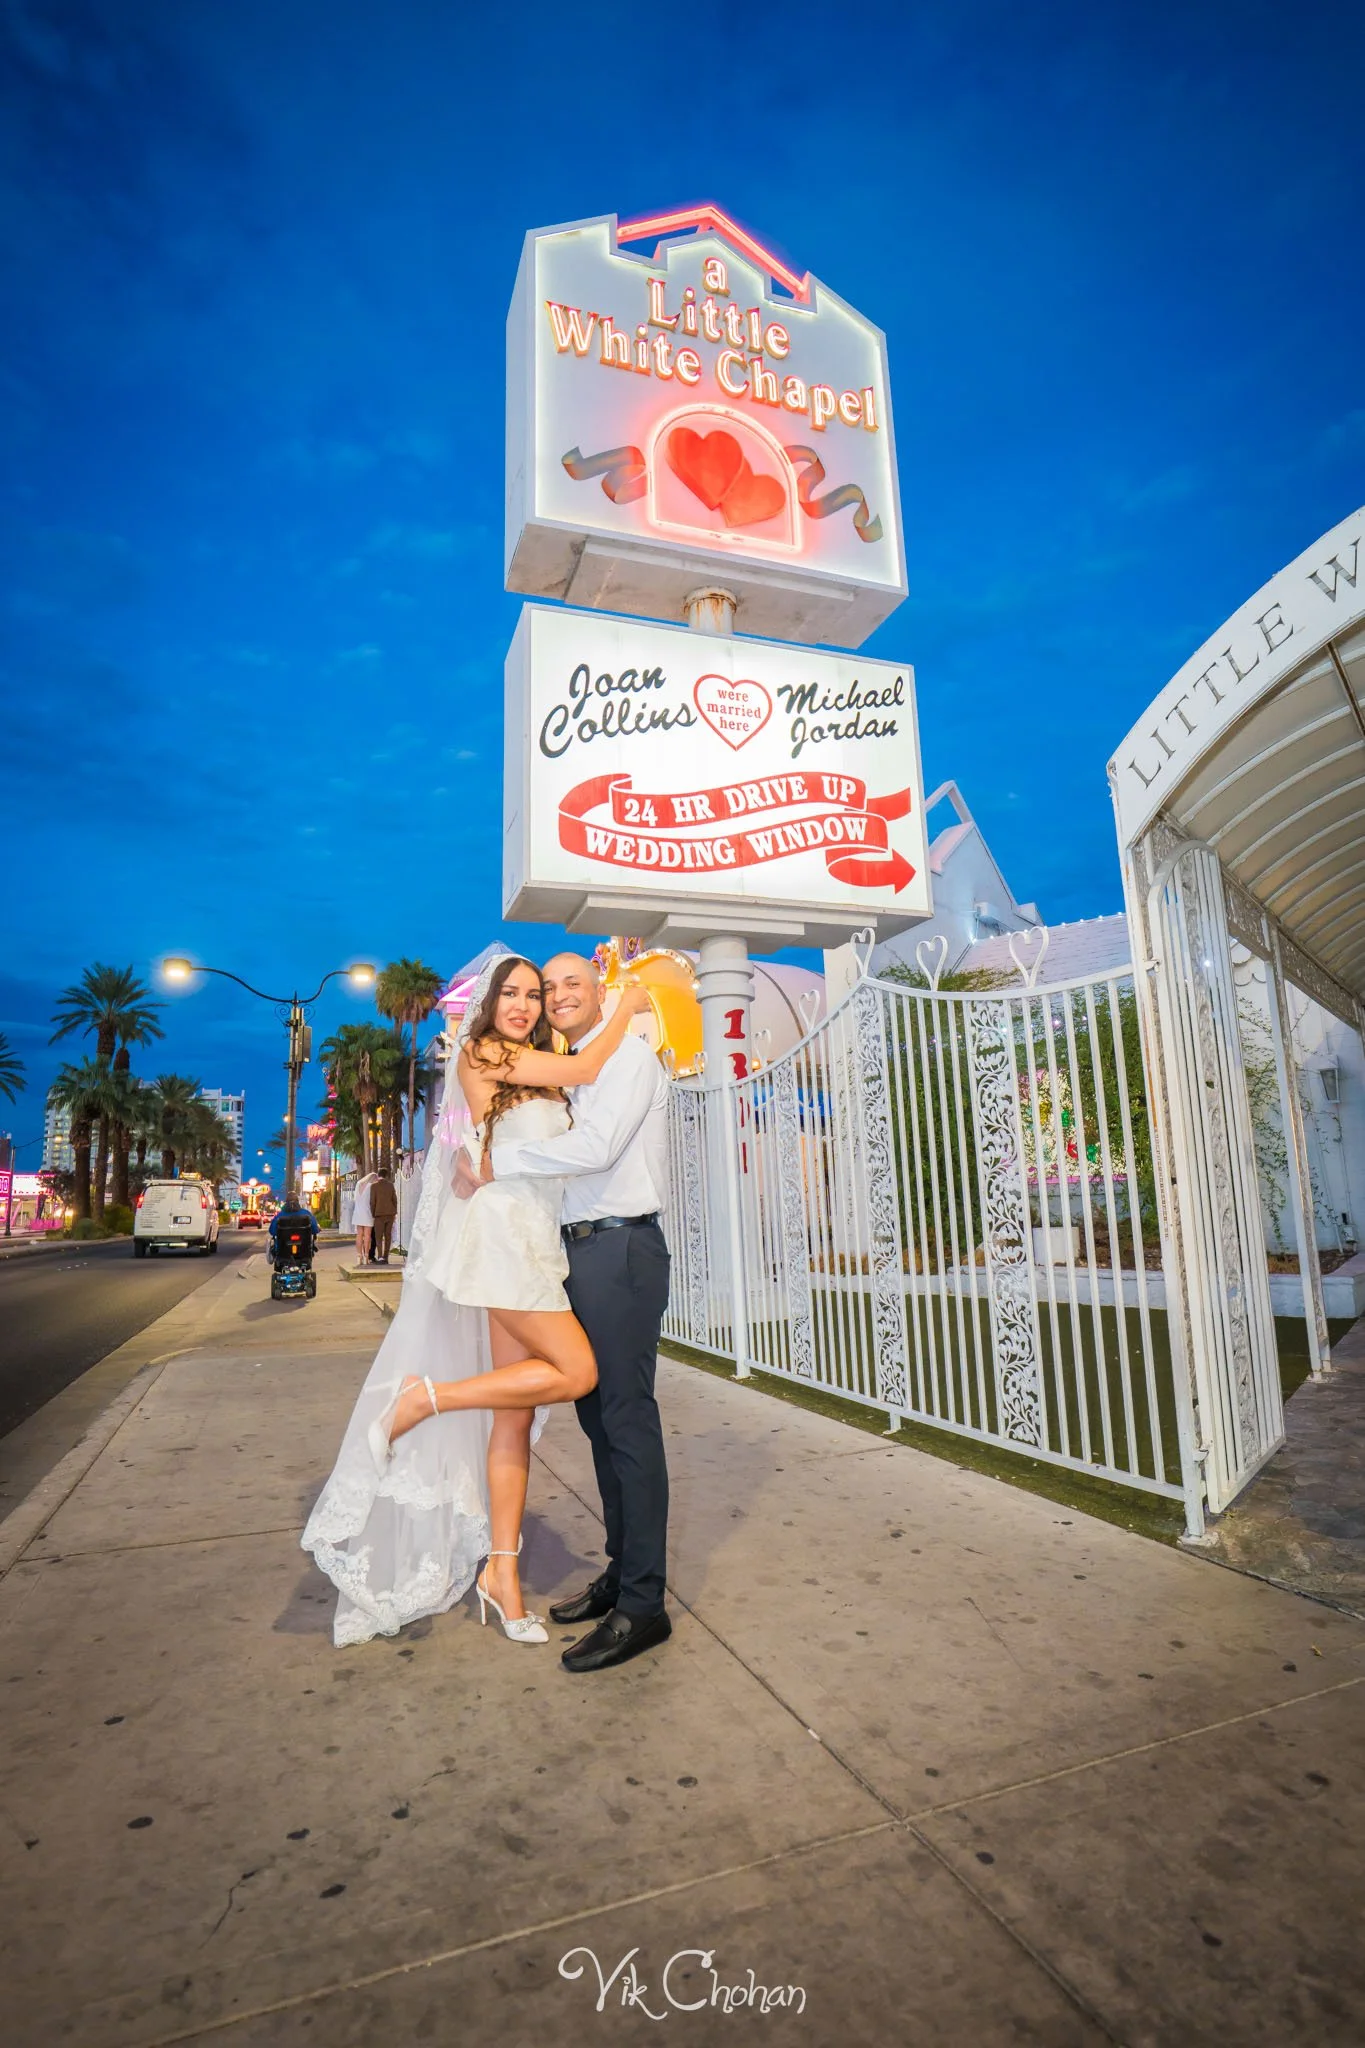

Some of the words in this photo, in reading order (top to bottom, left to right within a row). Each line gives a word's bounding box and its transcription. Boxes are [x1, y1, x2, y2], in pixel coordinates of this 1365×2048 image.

[702, 255, 730, 297] a
[647, 278, 790, 361] Little
[546, 301, 701, 386] White
[715, 349, 881, 432] Chapel
[569, 664, 667, 719] Joan
[706, 702, 762, 719] married
[717, 688, 749, 702] were
[777, 676, 905, 713] Michael
[1128, 602, 1294, 789] LITTLE
[539, 698, 698, 759] Collins
[719, 717, 750, 733] here
[790, 713, 899, 759] Jordan
[624, 799, 658, 827] 24
[671, 796, 716, 823] HR
[724, 775, 809, 819] DRIVE
[822, 776, 857, 803] UP
[585, 826, 737, 869] WEDDING
[746, 818, 868, 865] WINDOW
